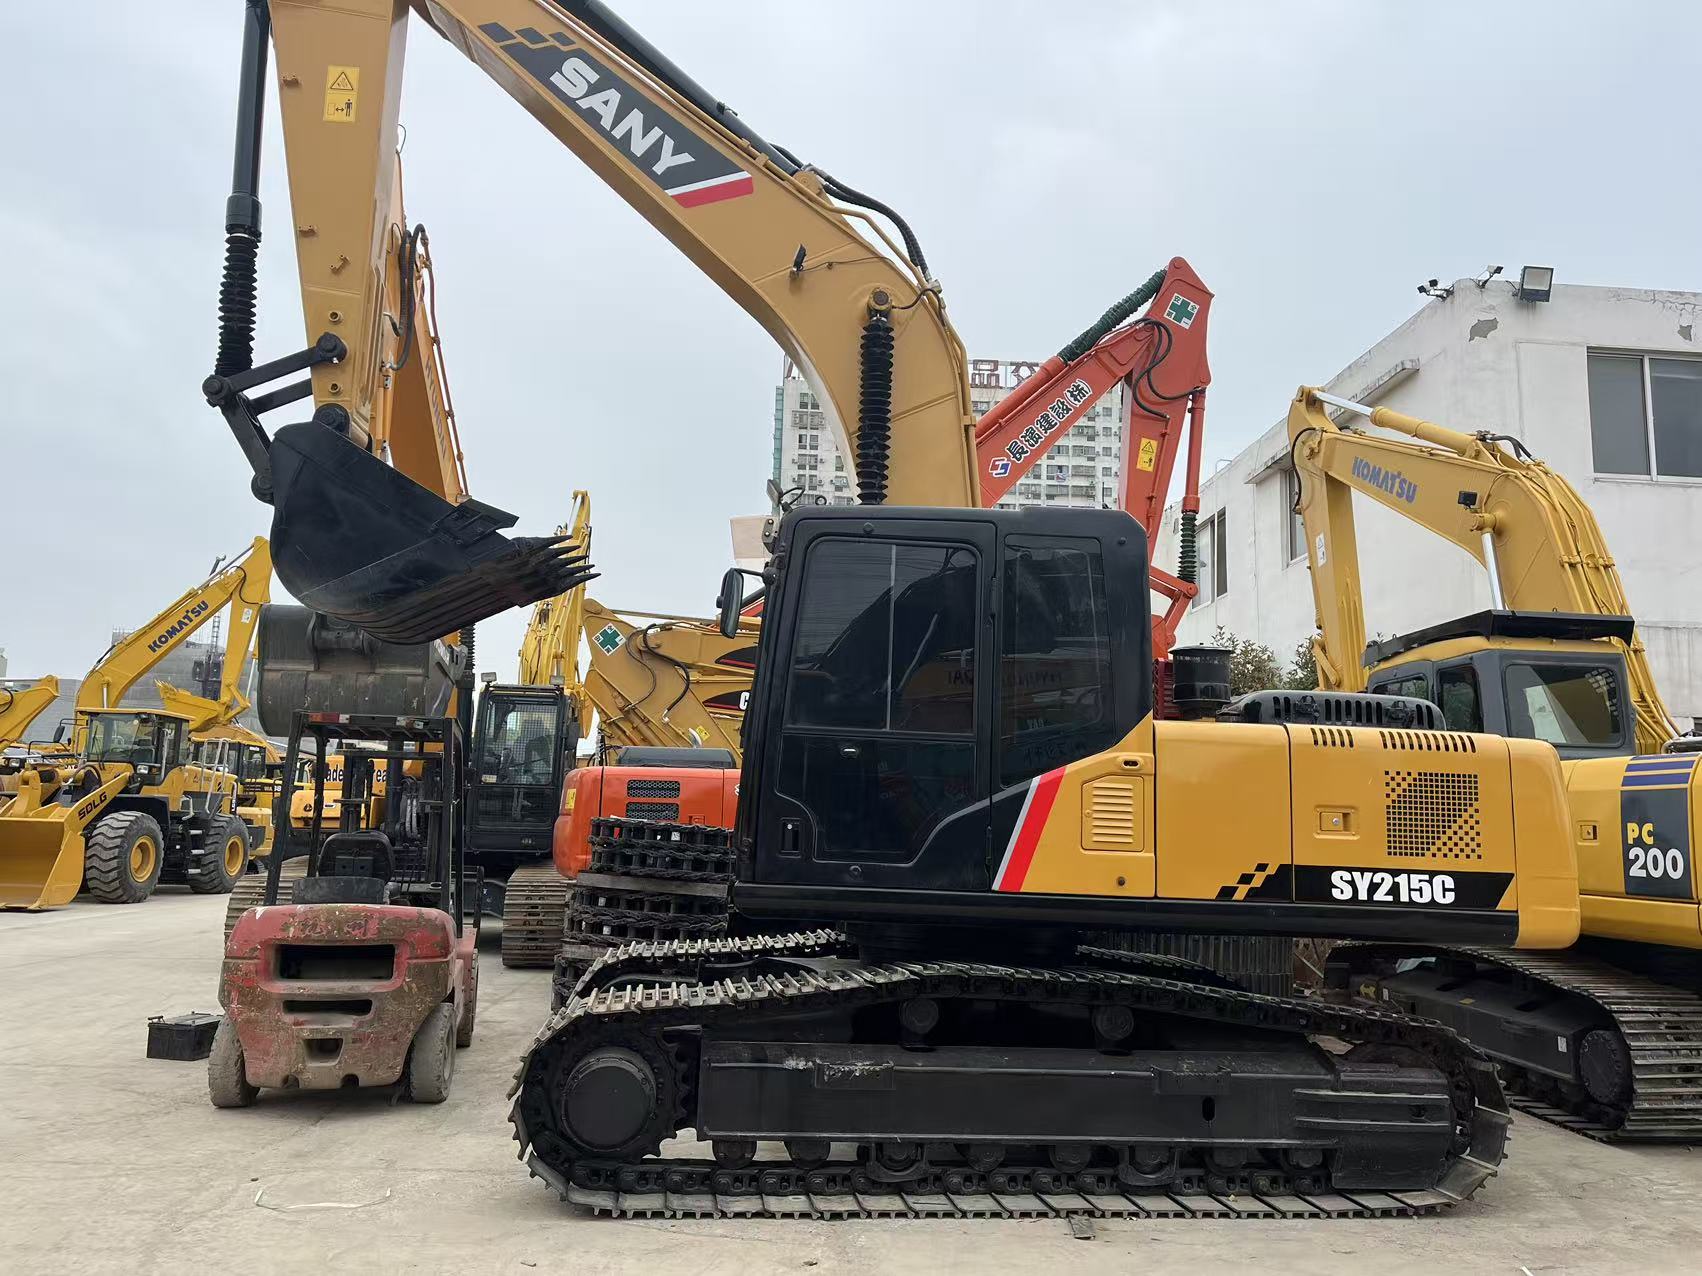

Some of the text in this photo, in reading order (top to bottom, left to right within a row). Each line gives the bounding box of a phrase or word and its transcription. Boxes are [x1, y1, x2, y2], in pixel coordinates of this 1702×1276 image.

[549, 57, 696, 176] SANY
[1351, 455, 1418, 503] KOMATSU
[147, 599, 209, 653] KOMATSU
[78, 791, 107, 820] SDLG
[1626, 822, 1654, 845] PC
[1628, 846, 1684, 880] 200
[1330, 870, 1456, 904] SY215C
